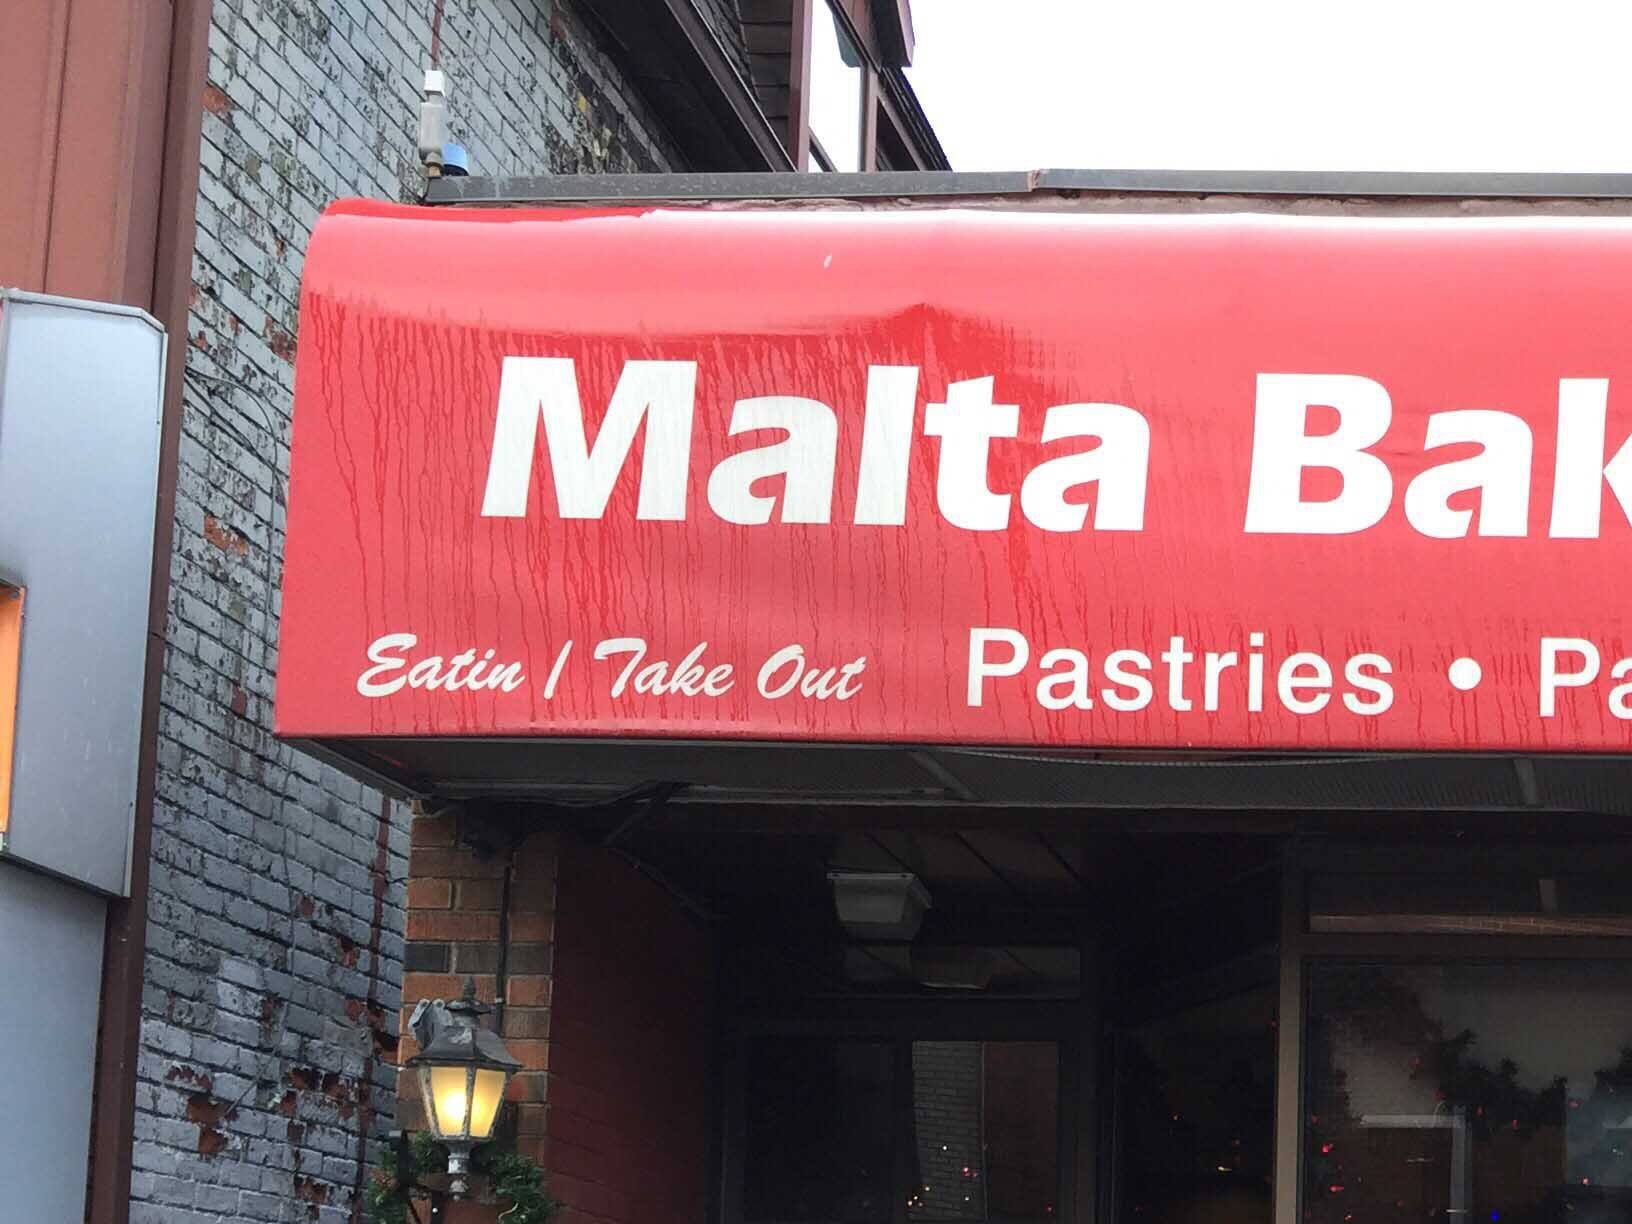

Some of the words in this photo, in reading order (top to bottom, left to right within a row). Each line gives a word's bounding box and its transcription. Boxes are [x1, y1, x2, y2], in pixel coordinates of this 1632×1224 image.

[481, 356, 1150, 532] Malta
[356, 633, 525, 697] Eatin
[594, 637, 734, 698] Take
[757, 644, 866, 700] Out
[967, 627, 1394, 715] Pastries
